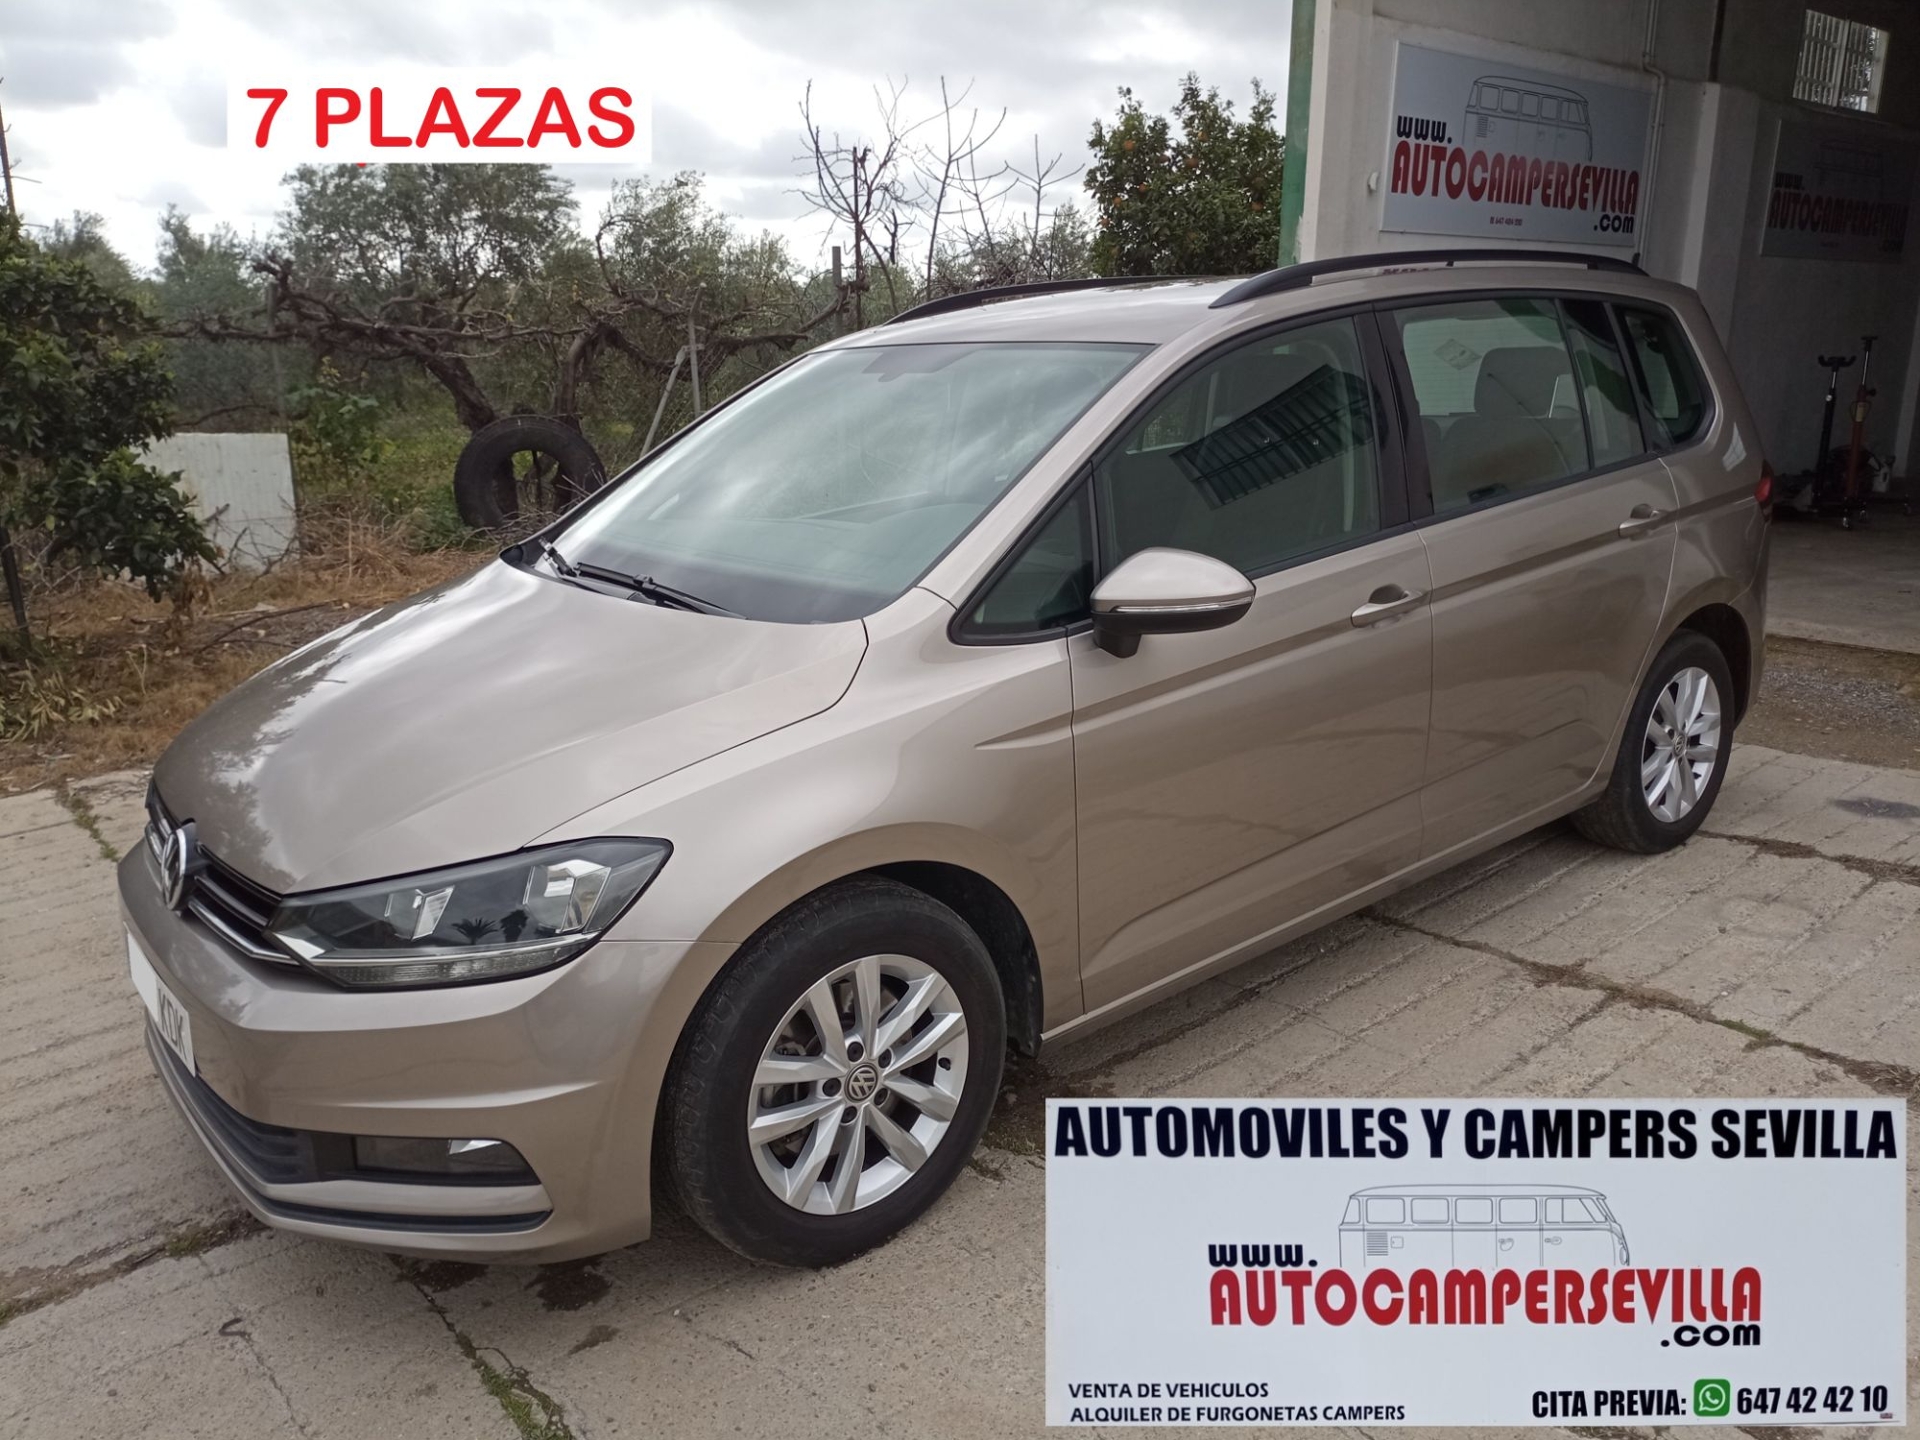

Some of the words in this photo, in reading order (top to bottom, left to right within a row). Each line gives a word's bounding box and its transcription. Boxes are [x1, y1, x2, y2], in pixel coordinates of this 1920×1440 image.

[1396, 115, 1453, 144] www.
[1391, 140, 1640, 215] AUTOCAMPERSEVILLA
[1593, 214, 1635, 234] .com
[157, 987, 188, 1061] KDK
